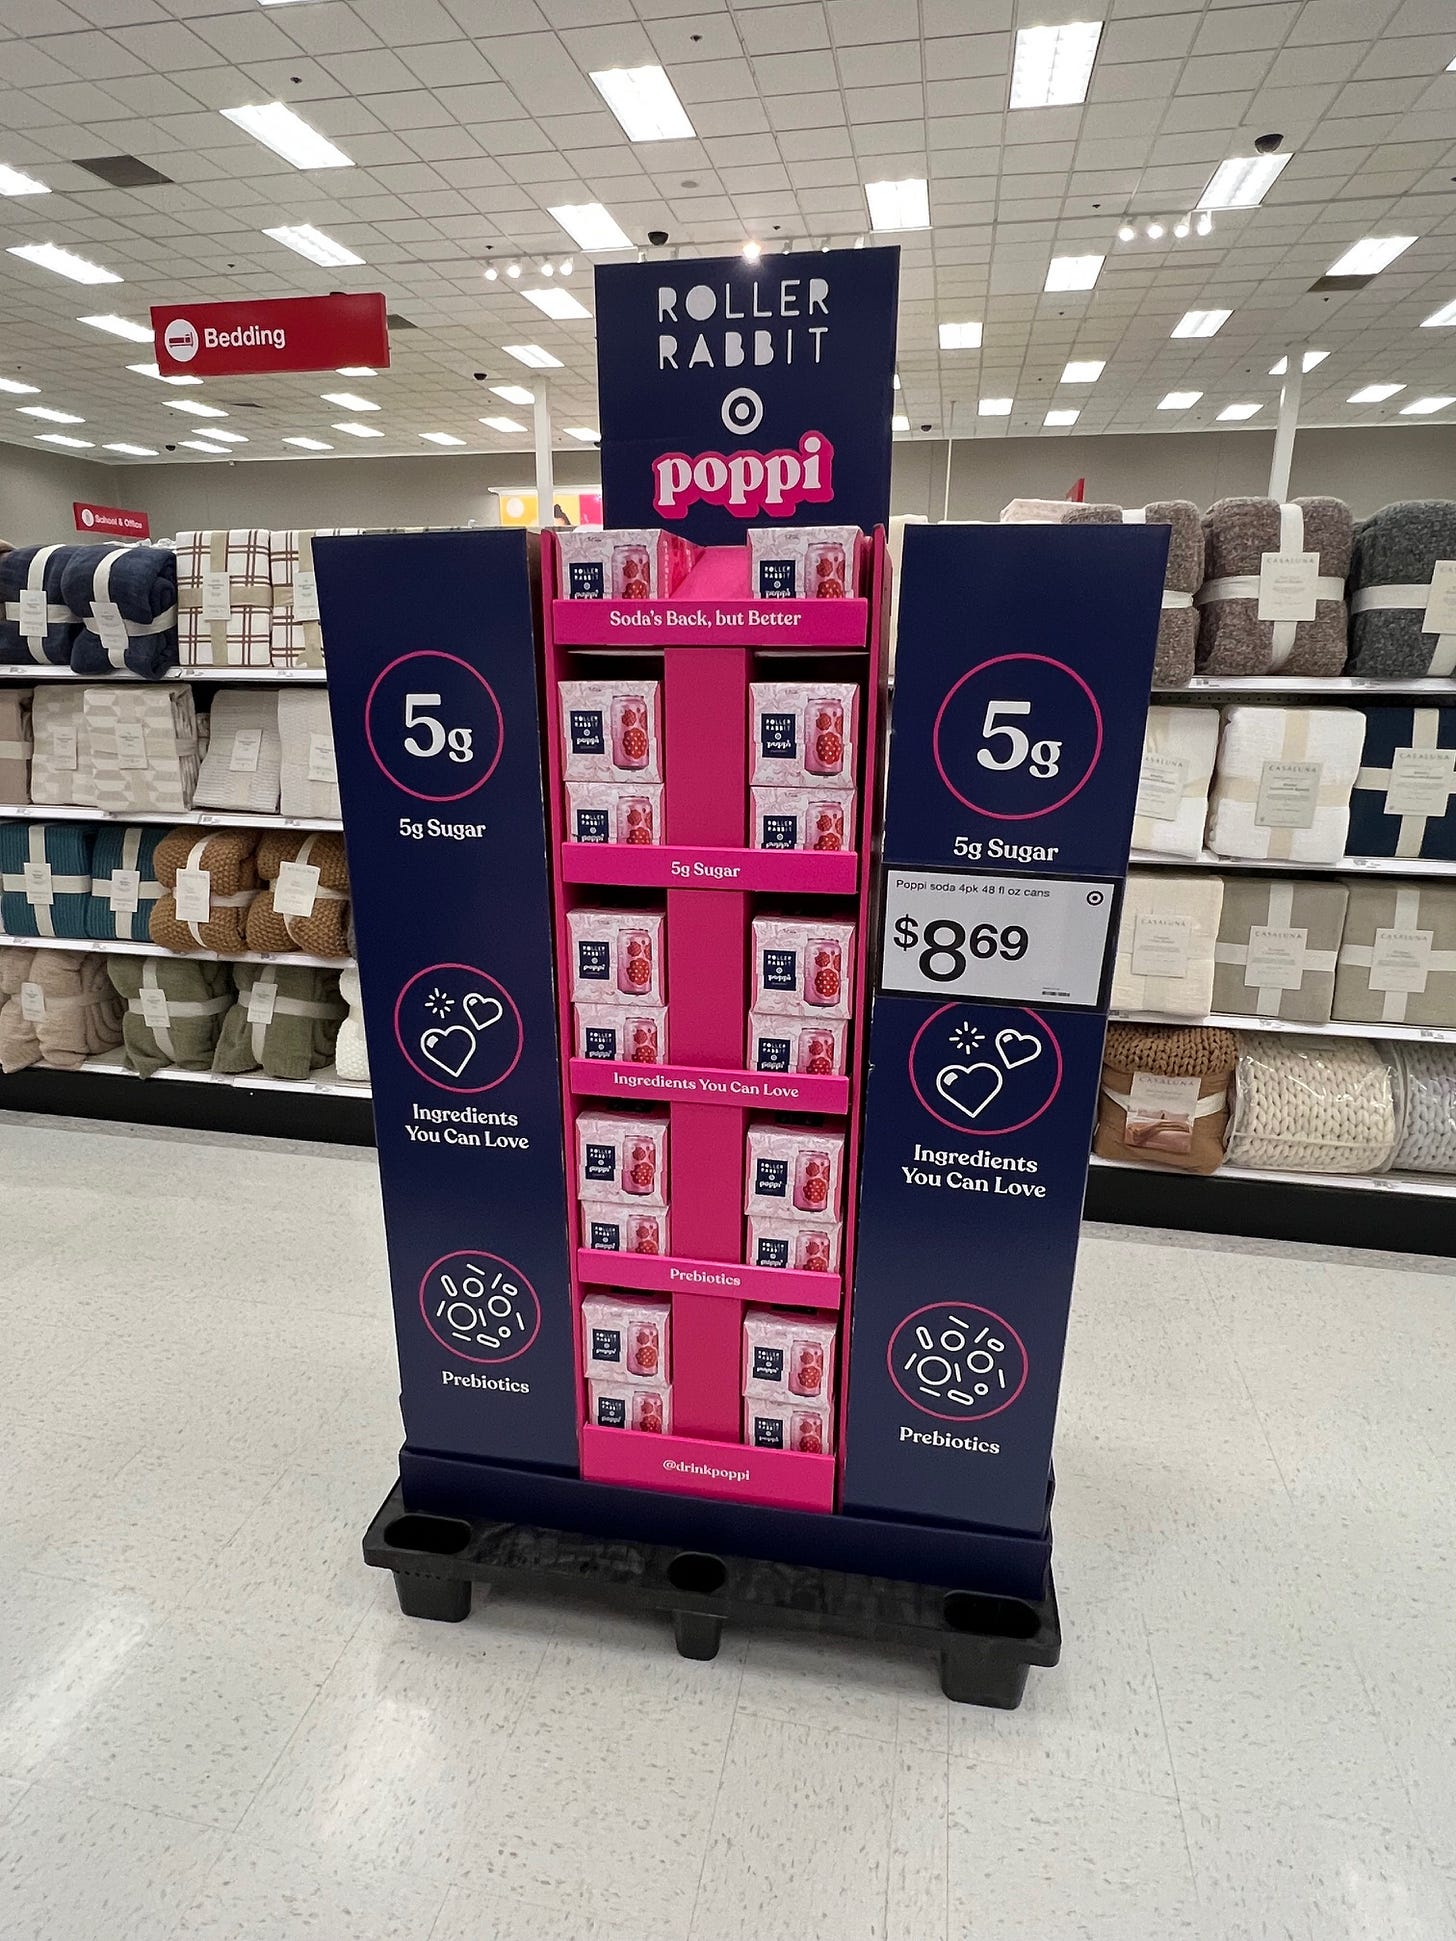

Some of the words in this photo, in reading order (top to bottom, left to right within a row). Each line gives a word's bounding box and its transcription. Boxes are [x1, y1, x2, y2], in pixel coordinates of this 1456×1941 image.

[658, 278, 829, 322] ROLLER
[204, 326, 285, 349] Bedding
[659, 327, 828, 370] RABBIT
[657, 436, 822, 506] poppi
[95, 515, 117, 525] School
[124, 519, 142, 528] Office
[610, 610, 662, 626] Soda's
[667, 610, 712, 628] Back,
[716, 609, 744, 625] but
[748, 611, 801, 626] Better
[404, 694, 473, 762] 5g
[977, 700, 1062, 778] 5g
[400, 818, 423, 839] 5g
[428, 819, 486, 840] Sugar
[954, 837, 982, 860] 5g
[988, 838, 1058, 862] Sugar
[671, 862, 690, 877] 5g
[694, 862, 740, 879] Sugar
[896, 880, 926, 890] Poppi
[930, 882, 956, 892] soda
[959, 884, 978, 894] 4pk
[982, 885, 995, 894] 48
[999, 885, 1004, 894] fl
[1008, 888, 1020, 896] oz
[1024, 888, 1050, 897] cans
[614, 1072, 696, 1090] Ingredients
[699, 1079, 727, 1092] You
[730, 1081, 760, 1095] Can
[763, 1084, 799, 1098] Love
[413, 1104, 518, 1126] Ingredients
[405, 1125, 441, 1143] You
[444, 1128, 481, 1146] Can
[485, 1131, 530, 1149] Love
[914, 1144, 1038, 1173] Ingredients
[902, 1167, 942, 1187] You
[946, 1171, 989, 1191] Can
[994, 1176, 1046, 1198] Love
[670, 1268, 740, 1286] Prebiotics
[442, 1371, 530, 1393] Prebiotics
[899, 1427, 1000, 1454] Prebiotics
[663, 1459, 749, 1481] @drinkpoppi
